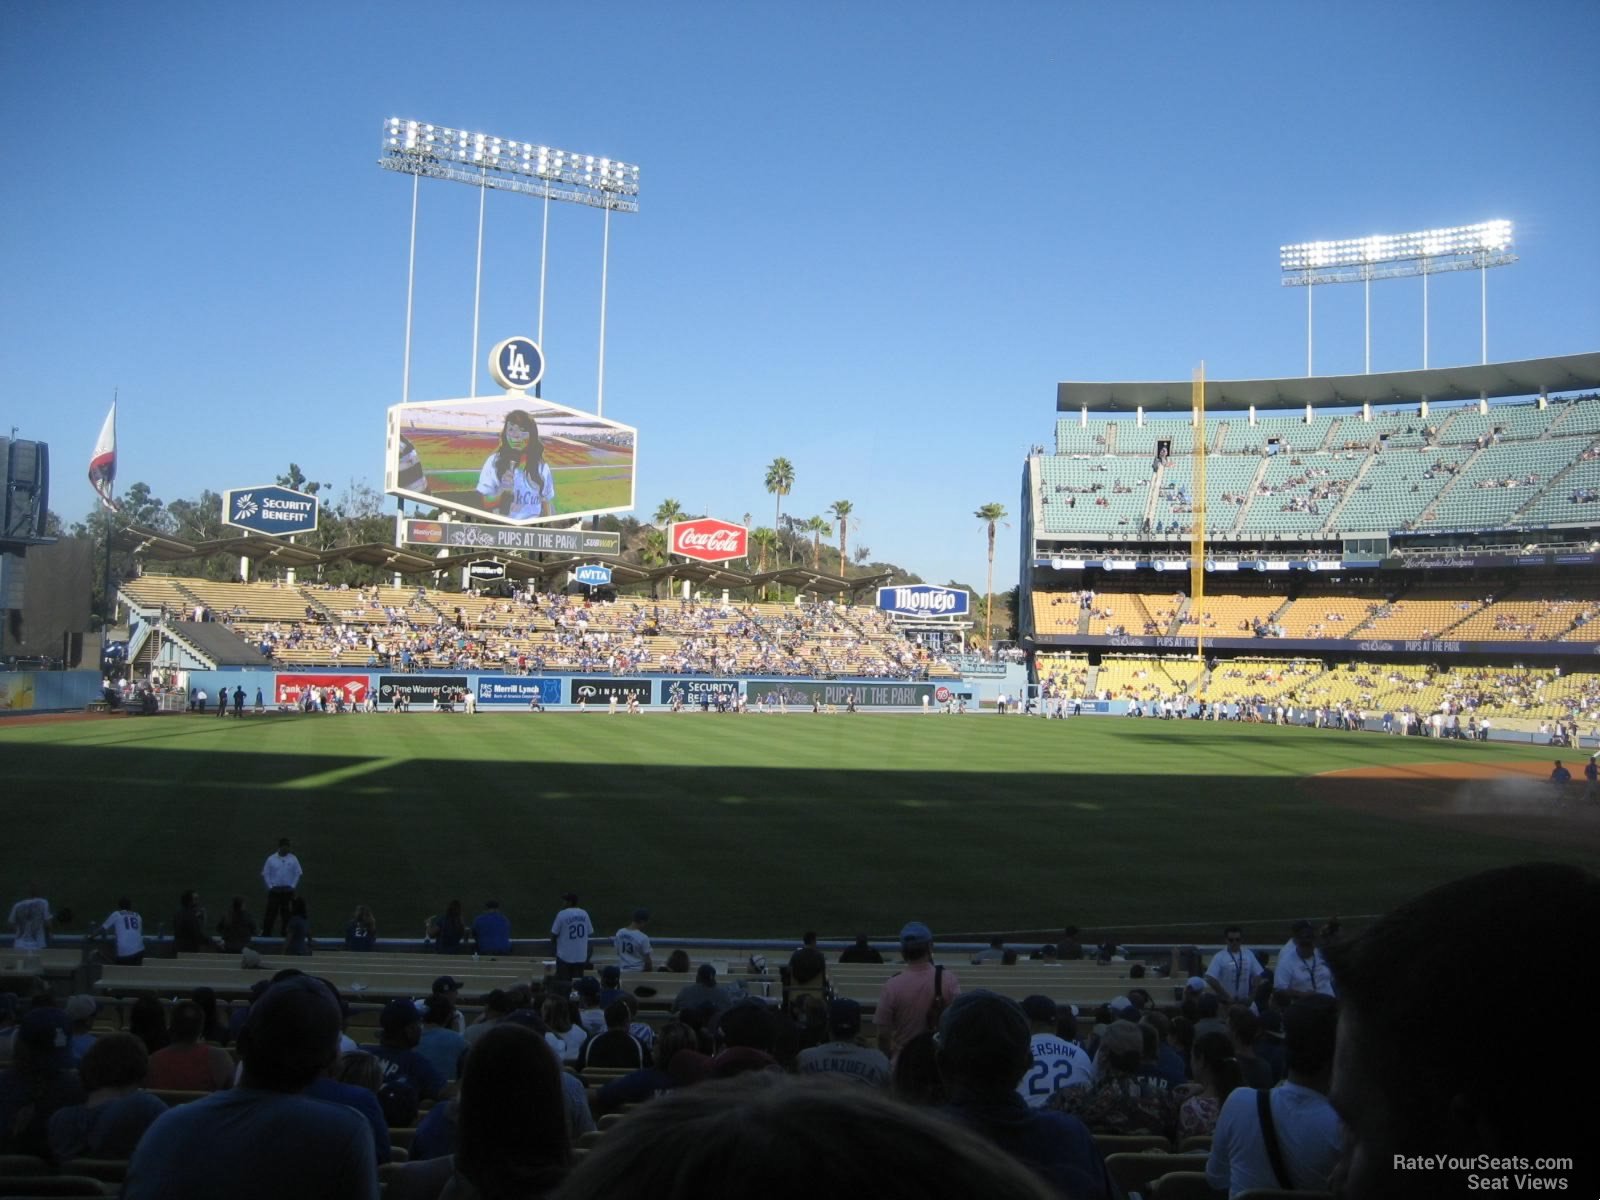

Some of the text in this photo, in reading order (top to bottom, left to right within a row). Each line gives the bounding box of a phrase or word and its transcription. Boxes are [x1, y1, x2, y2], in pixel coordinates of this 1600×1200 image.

[507, 344, 531, 380] LA
[262, 497, 312, 511] SECURITY
[262, 509, 305, 522] BENEFIT
[498, 530, 578, 550] PUPS AT THE PARK
[584, 538, 618, 549] SUBWAY
[894, 588, 956, 613] Montejo
[1156, 636, 1214, 648] PUPS AT THE ARK
[1405, 640, 1460, 652] PUPS AT THE PARK
[494, 684, 540, 694] Merrill Lynch
[688, 681, 734, 692] SECURITY
[825, 686, 917, 705] PUPS AT THE PARK
[569, 923, 585, 940] 20
[622, 940, 634, 954] 13
[1030, 1042, 1077, 1059] ERSHAW
[1028, 1059, 1073, 1095] 22
